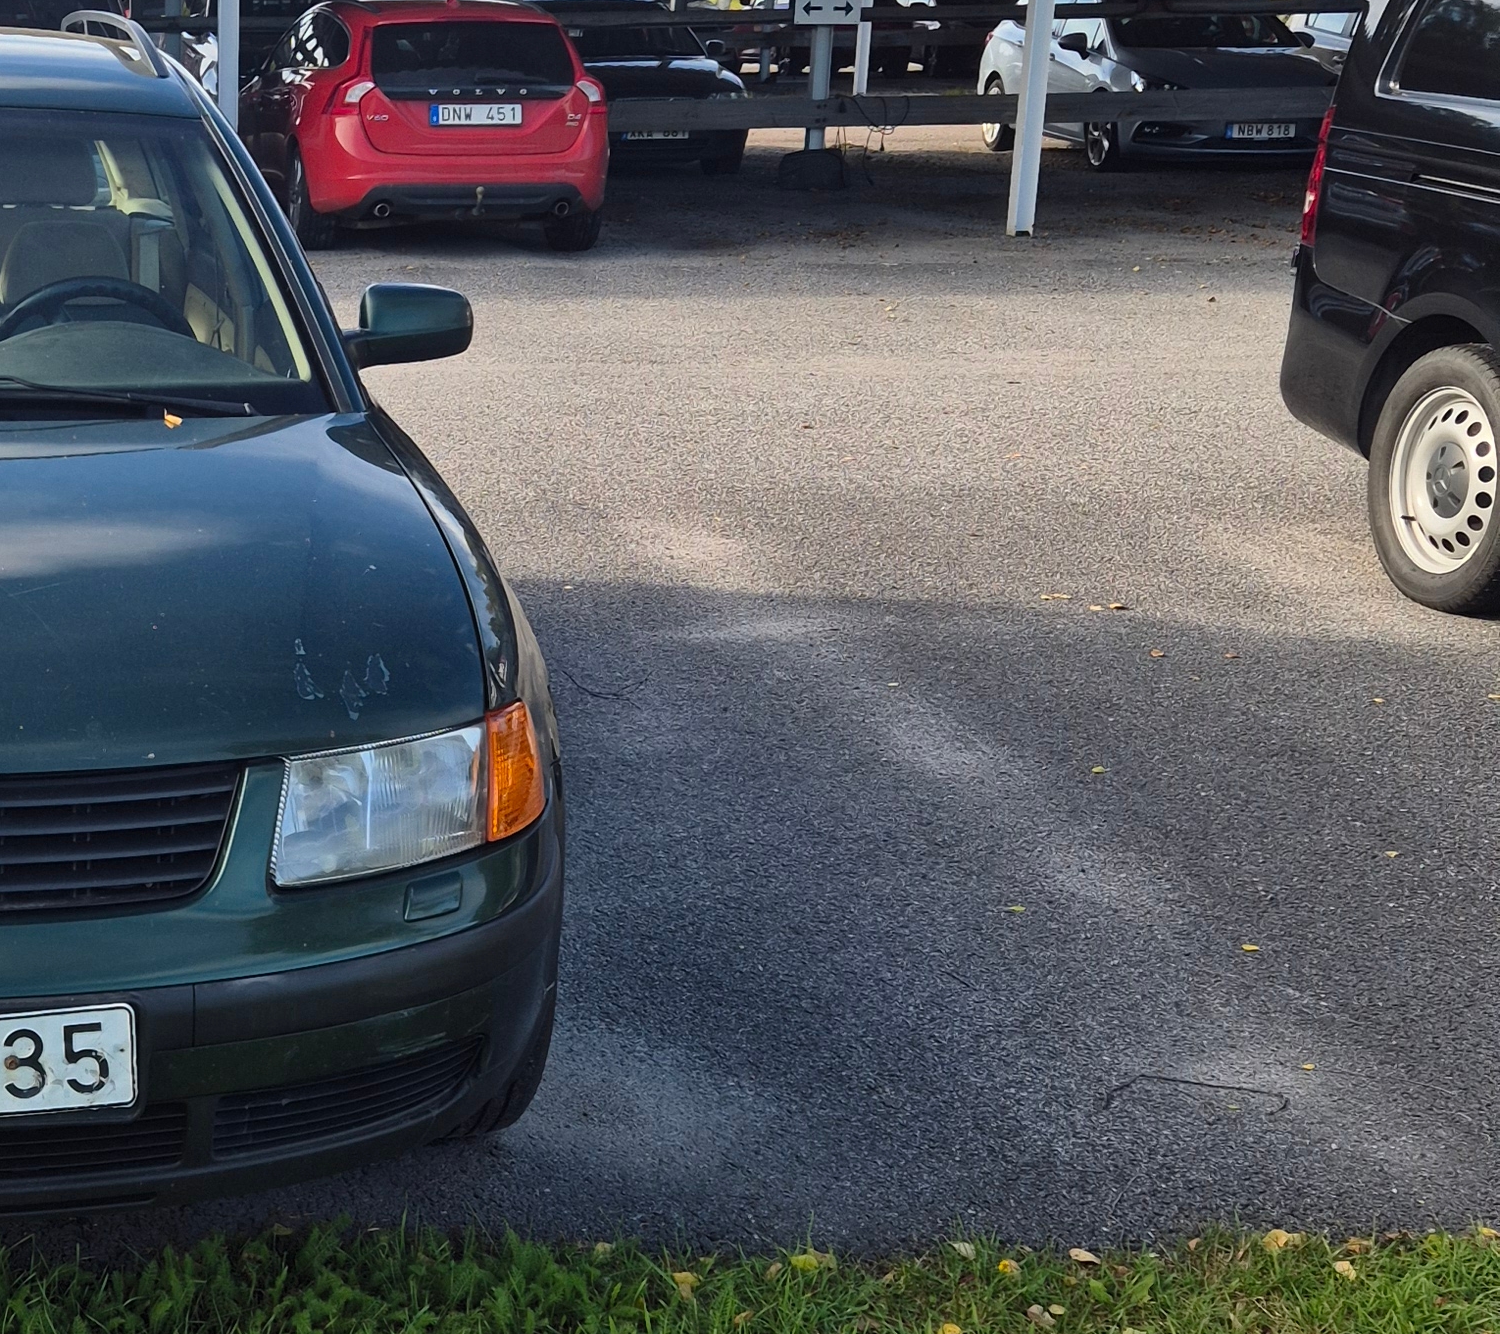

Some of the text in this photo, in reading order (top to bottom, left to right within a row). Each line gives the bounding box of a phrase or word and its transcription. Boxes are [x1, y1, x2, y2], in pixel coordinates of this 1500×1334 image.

[428, 88, 529, 96] VOLVO
[441, 107, 517, 122] DNW 451
[1238, 124, 1290, 136] NBW 818
